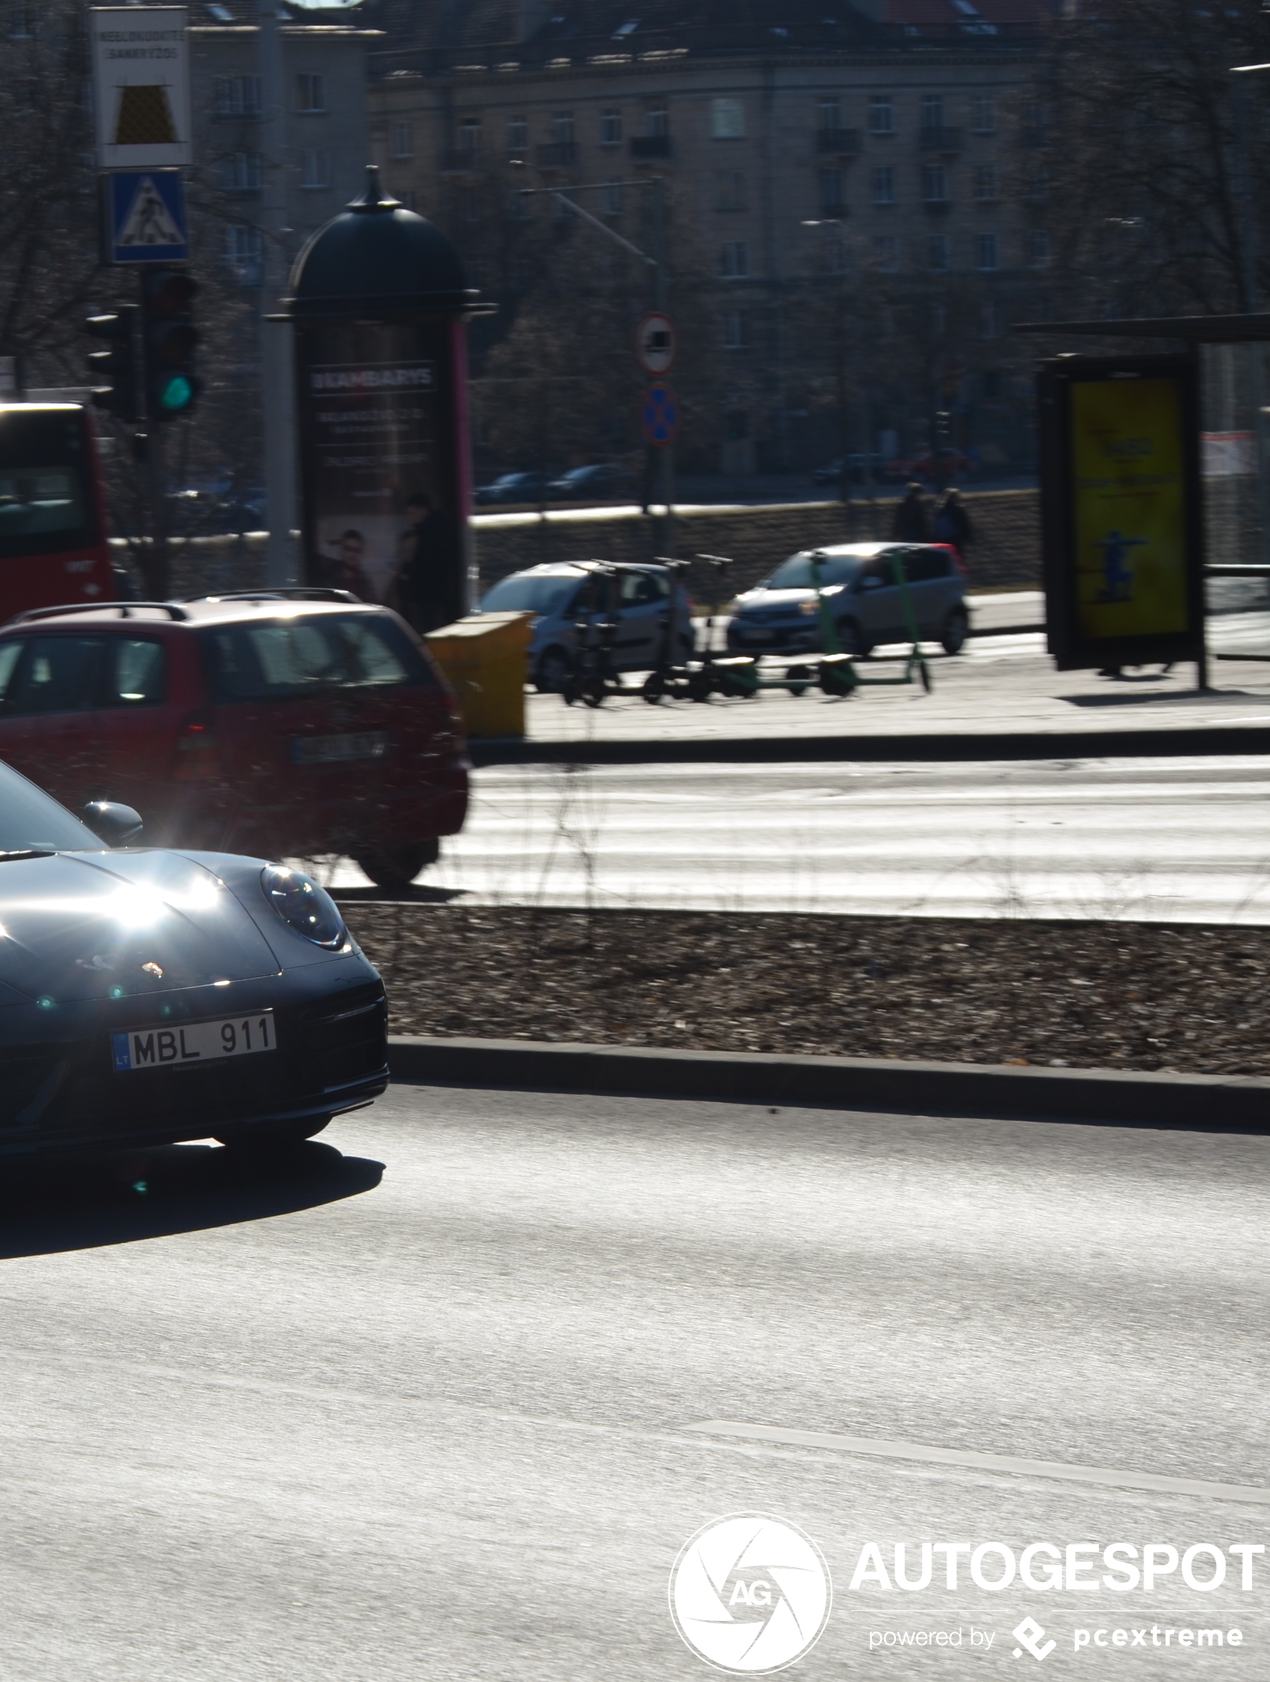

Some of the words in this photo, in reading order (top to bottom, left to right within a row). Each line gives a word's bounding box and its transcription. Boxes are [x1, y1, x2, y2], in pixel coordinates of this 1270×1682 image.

[116, 1056, 128, 1065] LT
[134, 1029, 200, 1065] MBL
[221, 1018, 268, 1053] 911
